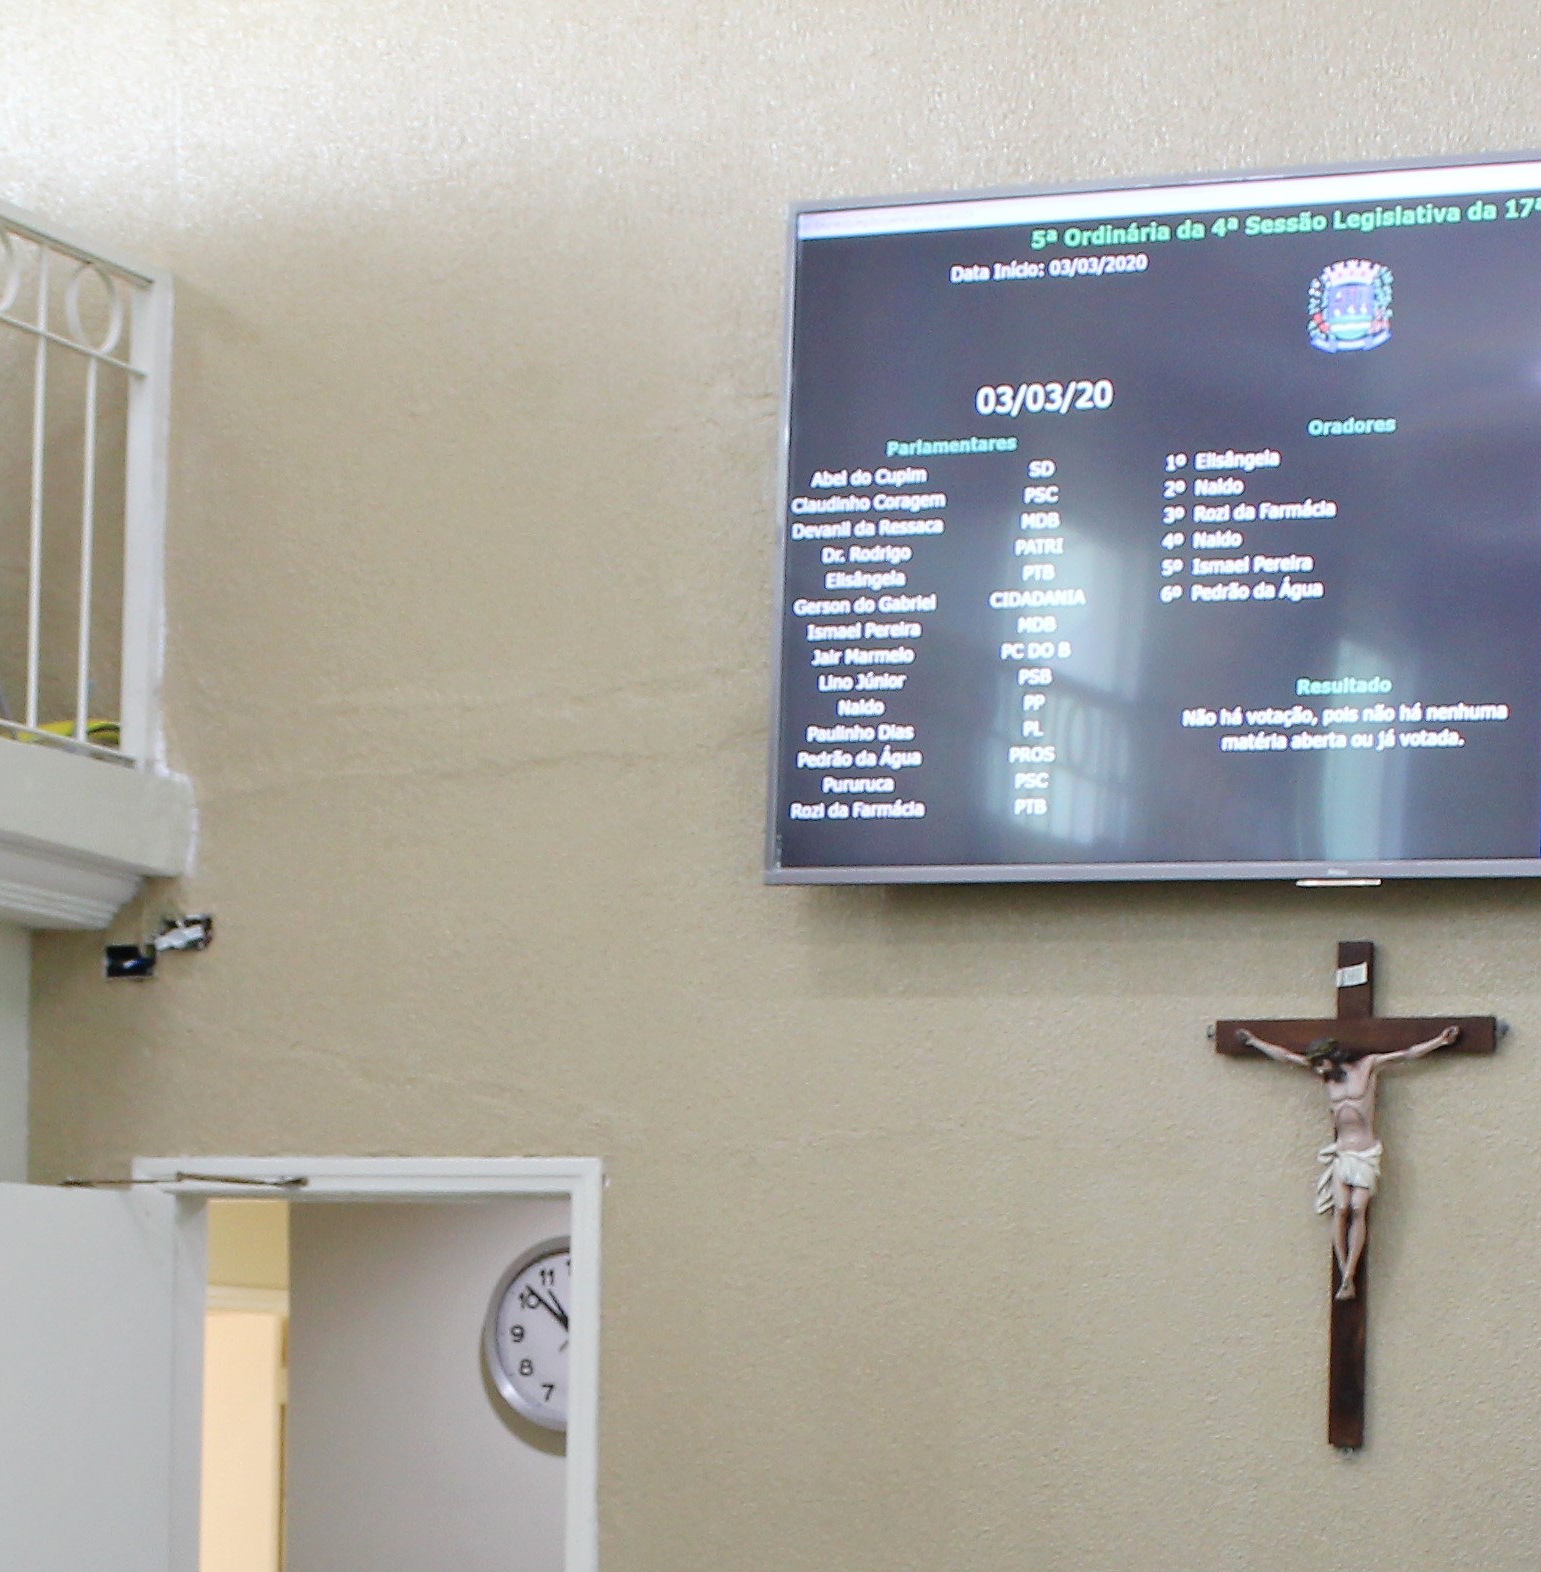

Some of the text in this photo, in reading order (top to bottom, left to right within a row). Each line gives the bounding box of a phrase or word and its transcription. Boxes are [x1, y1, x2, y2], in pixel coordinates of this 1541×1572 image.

[1064, 221, 1170, 248] Ordinária
[1177, 220, 1205, 240] da
[1246, 212, 1327, 235] Sessão
[1334, 201, 1460, 232] Legislativa
[1468, 200, 1496, 222] da
[951, 253, 1148, 283] Data Início: 03/03/2020
[975, 378, 1114, 417] 03/03/20
[1308, 416, 1396, 436] Oradores
[886, 437, 1017, 456] Parlamentares
[1028, 459, 1055, 478] SD
[1194, 449, 1280, 471] Elisângela
[811, 467, 927, 488] Abel do Cupim
[1194, 478, 1244, 496] Naldo
[791, 493, 947, 515] Claudinho Coragem
[1023, 486, 1059, 504] PSC
[1193, 505, 1229, 523] Rozi
[1233, 503, 1255, 521] da
[1260, 498, 1337, 520] Farmácia
[792, 518, 944, 539] Devanil da Ressaca
[1021, 512, 1060, 529] MDB
[1015, 539, 1063, 556] PATRI
[1193, 530, 1243, 549] Naldo
[821, 546, 911, 564] Dr. Rodrigo
[1022, 565, 1055, 581] PTB
[1192, 557, 1248, 576] Ismael
[1253, 555, 1314, 572] Pereira
[825, 570, 906, 590] Elisângela
[1191, 582, 1249, 601] Pedrão
[1254, 582, 1276, 599] da
[1279, 576, 1324, 602] Água
[793, 594, 936, 616] Gerson do Gabriel
[989, 590, 1086, 608] CIDADANIA
[807, 622, 921, 641] Ismael Pereira
[1018, 617, 1057, 633] MDB
[811, 647, 914, 666] Jair Marmelo
[1001, 642, 1071, 659] PC DO B
[818, 671, 907, 691] Lino Júnior
[1018, 669, 1052, 685] PSB
[1297, 677, 1391, 696] Resultado
[837, 699, 885, 716] Naldo
[1023, 694, 1045, 711] PP
[1182, 702, 1508, 727] Não há votação, pois não há nenhuma
[807, 723, 914, 743] Paulinho Dias
[1022, 721, 1043, 737] PL
[1222, 729, 1465, 751] matéria aberta ou já votada.
[797, 746, 922, 769] Pedrão da Água
[1009, 746, 1055, 763] PROS
[822, 777, 895, 794] Pururuca
[1015, 773, 1049, 789] PSC
[790, 799, 925, 819] Rozi da Farmácia
[1014, 799, 1046, 815] PTB
[540, 1270, 555, 1286] 11
[519, 1291, 541, 1310] 10
[510, 1324, 524, 1343] 9
[518, 1359, 534, 1376] 8
[542, 1384, 555, 1401] 7
